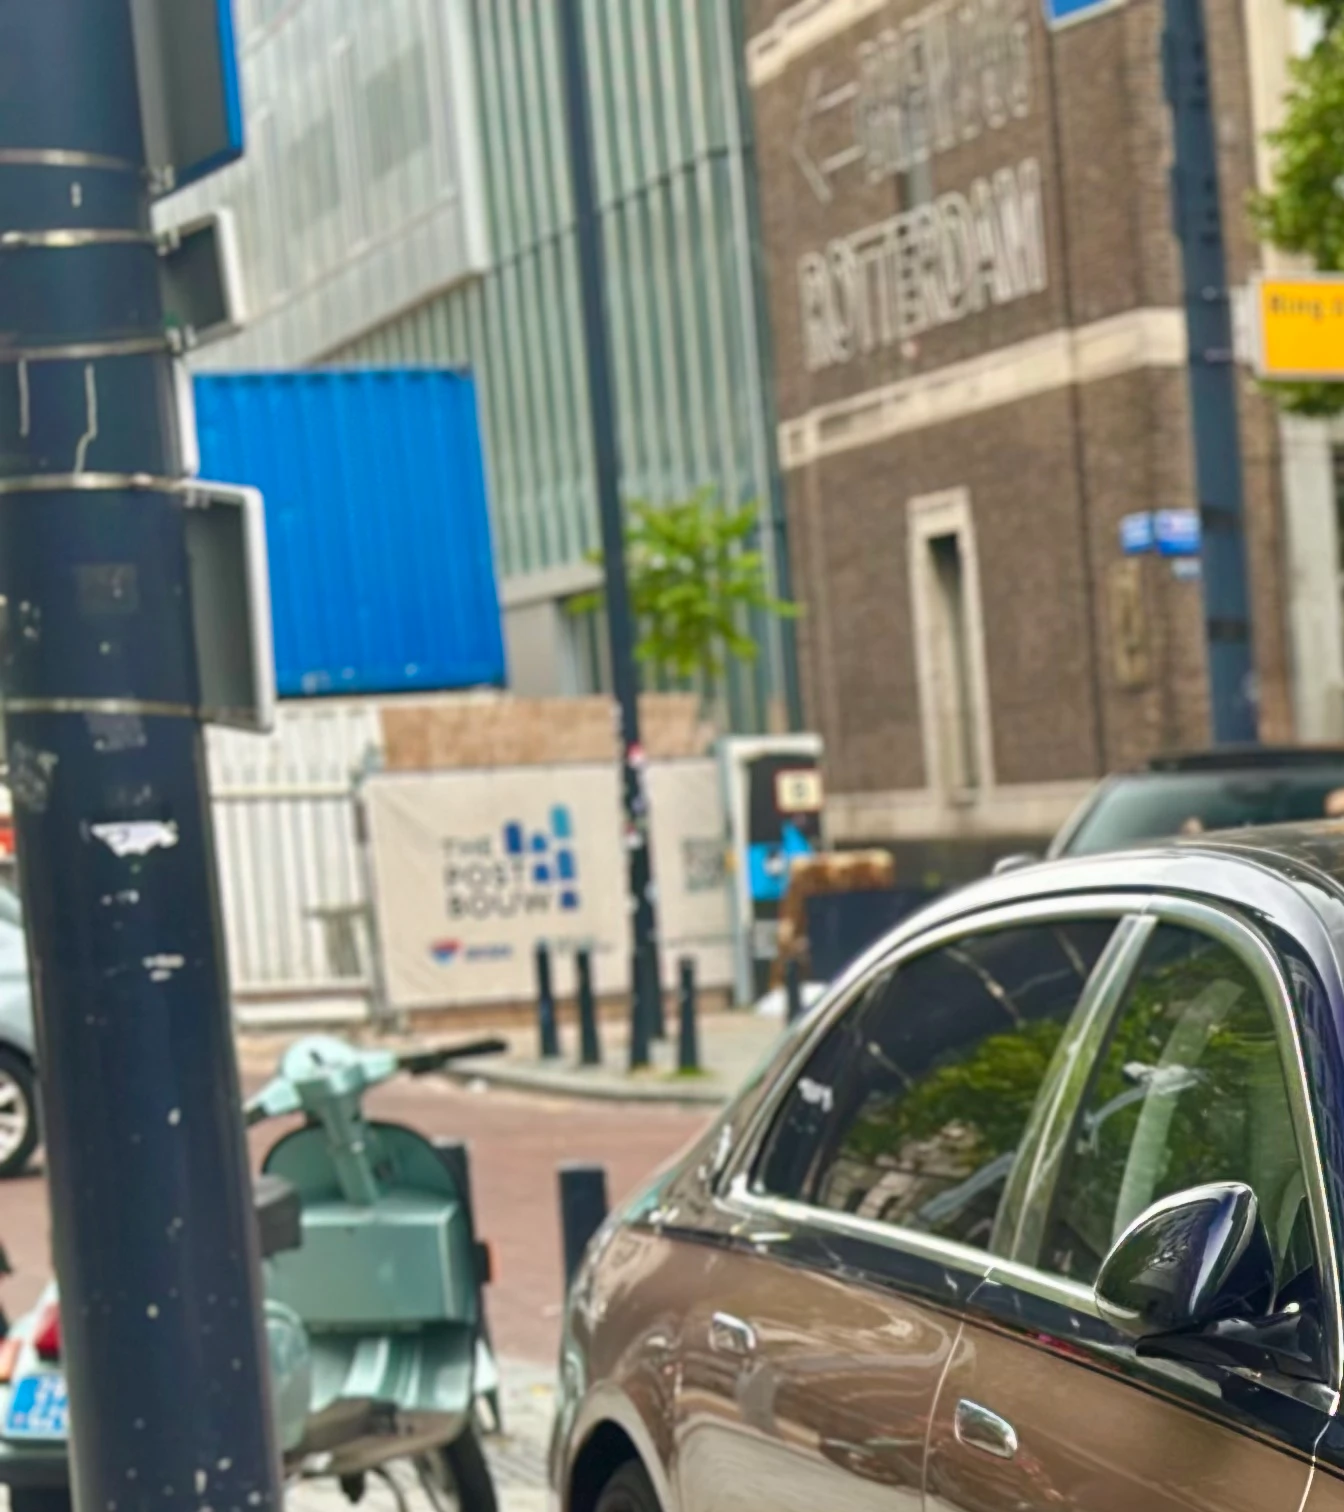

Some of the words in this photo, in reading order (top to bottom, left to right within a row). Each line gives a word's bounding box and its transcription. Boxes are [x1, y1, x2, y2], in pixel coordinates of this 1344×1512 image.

[796, 156, 1048, 372] ROTTERDAM
[443, 836, 491, 857] THE
[446, 860, 526, 888] POST
[447, 890, 551, 919] BOUW
